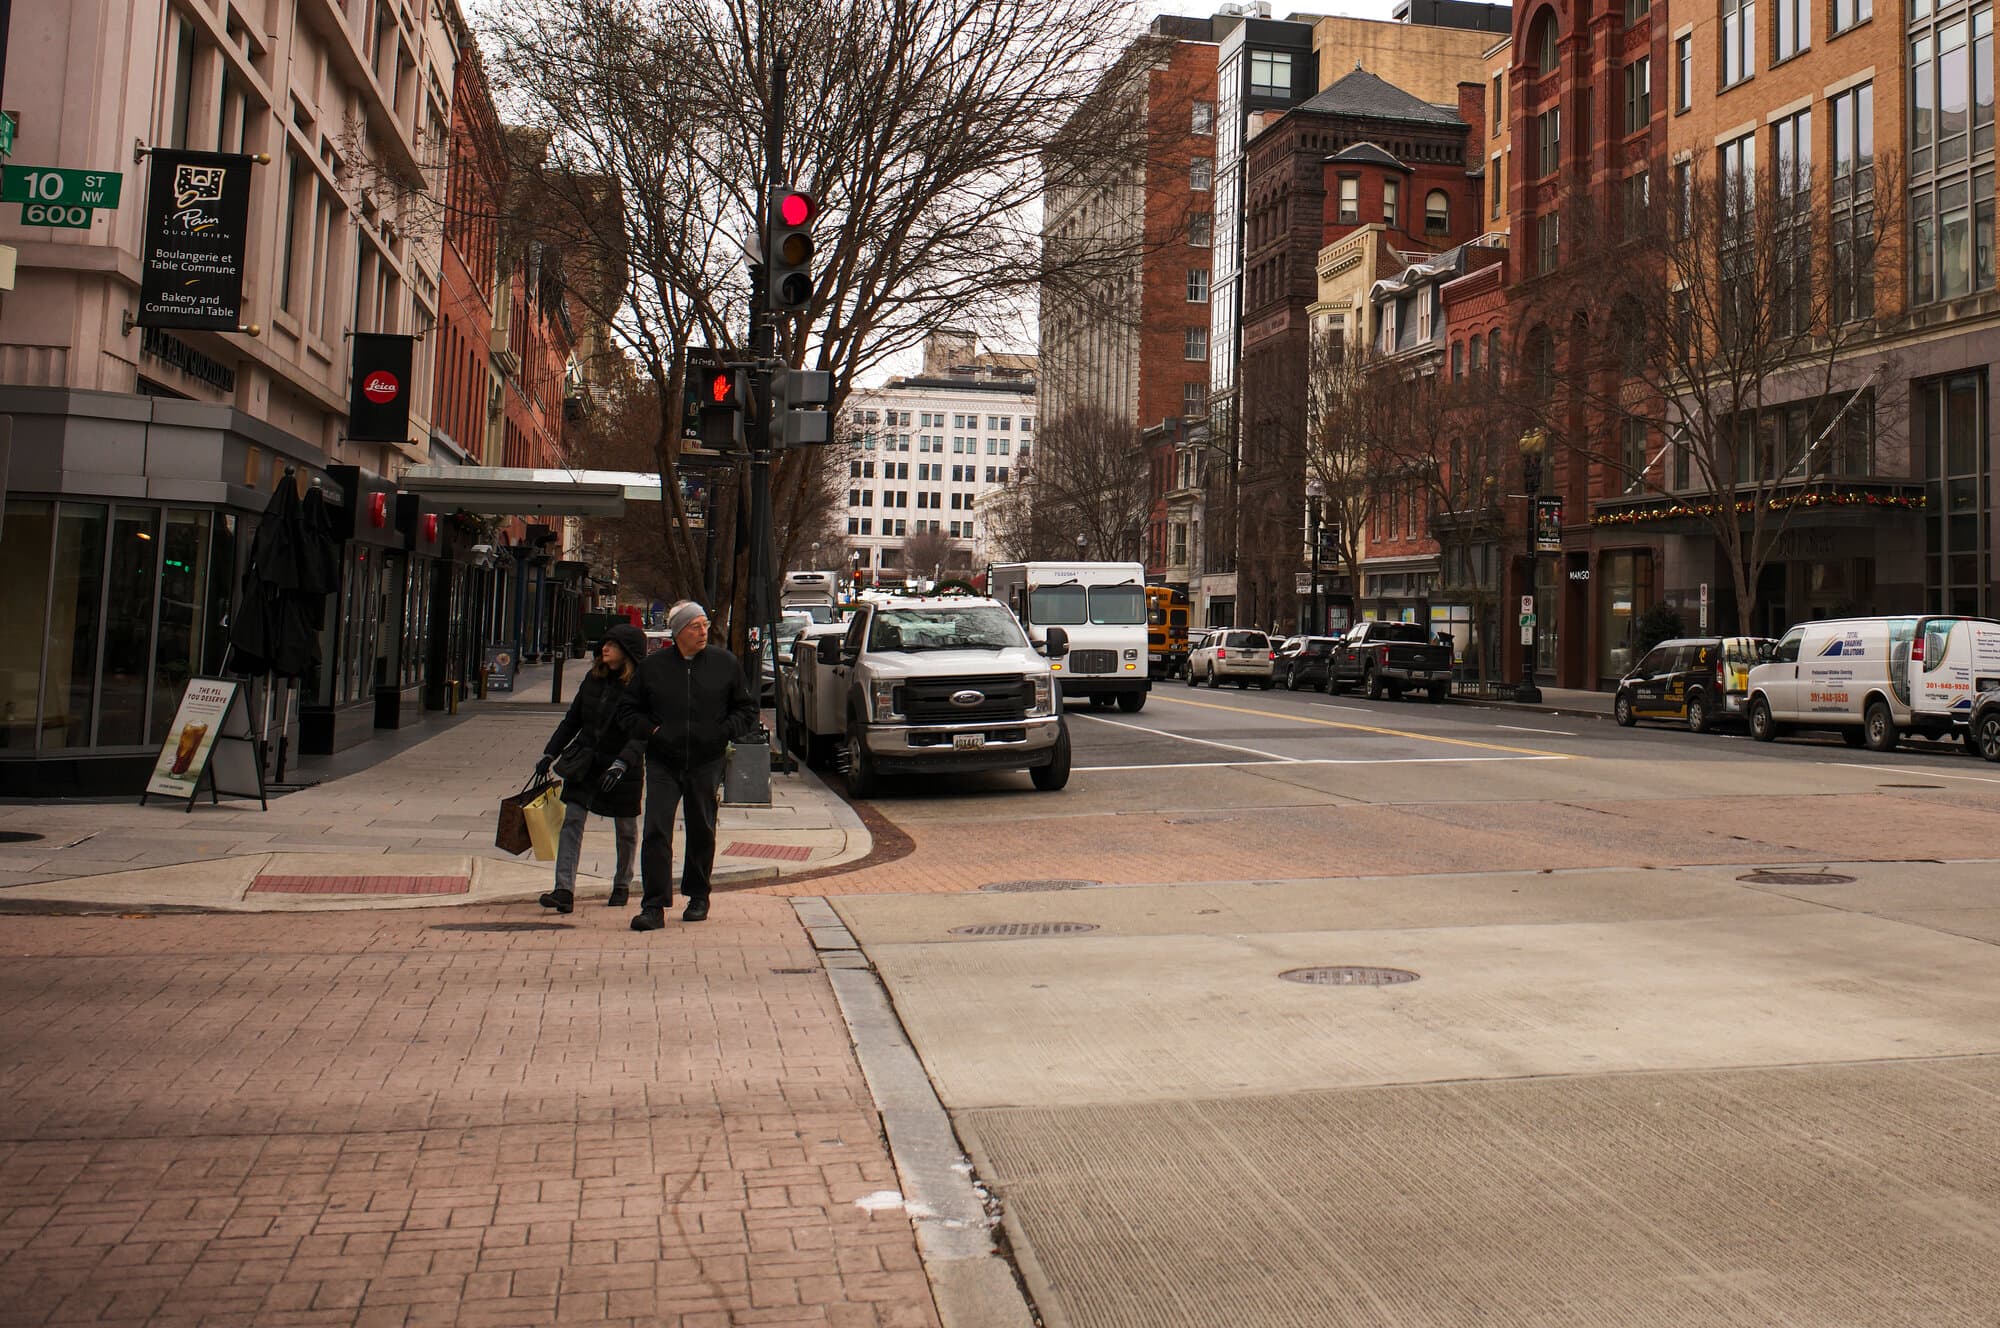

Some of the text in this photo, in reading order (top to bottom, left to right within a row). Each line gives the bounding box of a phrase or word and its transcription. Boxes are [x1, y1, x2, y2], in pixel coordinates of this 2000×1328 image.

[23, 172, 106, 200] 10 ST
[81, 191, 104, 203] NW
[26, 204, 87, 225] 600
[172, 208, 219, 229] Pain
[163, 229, 230, 239] QUOTIDIEN
[156, 249, 232, 263] Boulangerie et
[151, 260, 236, 275] Table Commune
[161, 292, 220, 305] Bakery and
[145, 302, 234, 317] Communal Table
[366, 379, 395, 392] Leica
[1570, 570, 1589, 580] MANGO
[199, 687, 210, 695] THE
[201, 695, 227, 704] DESERVE
